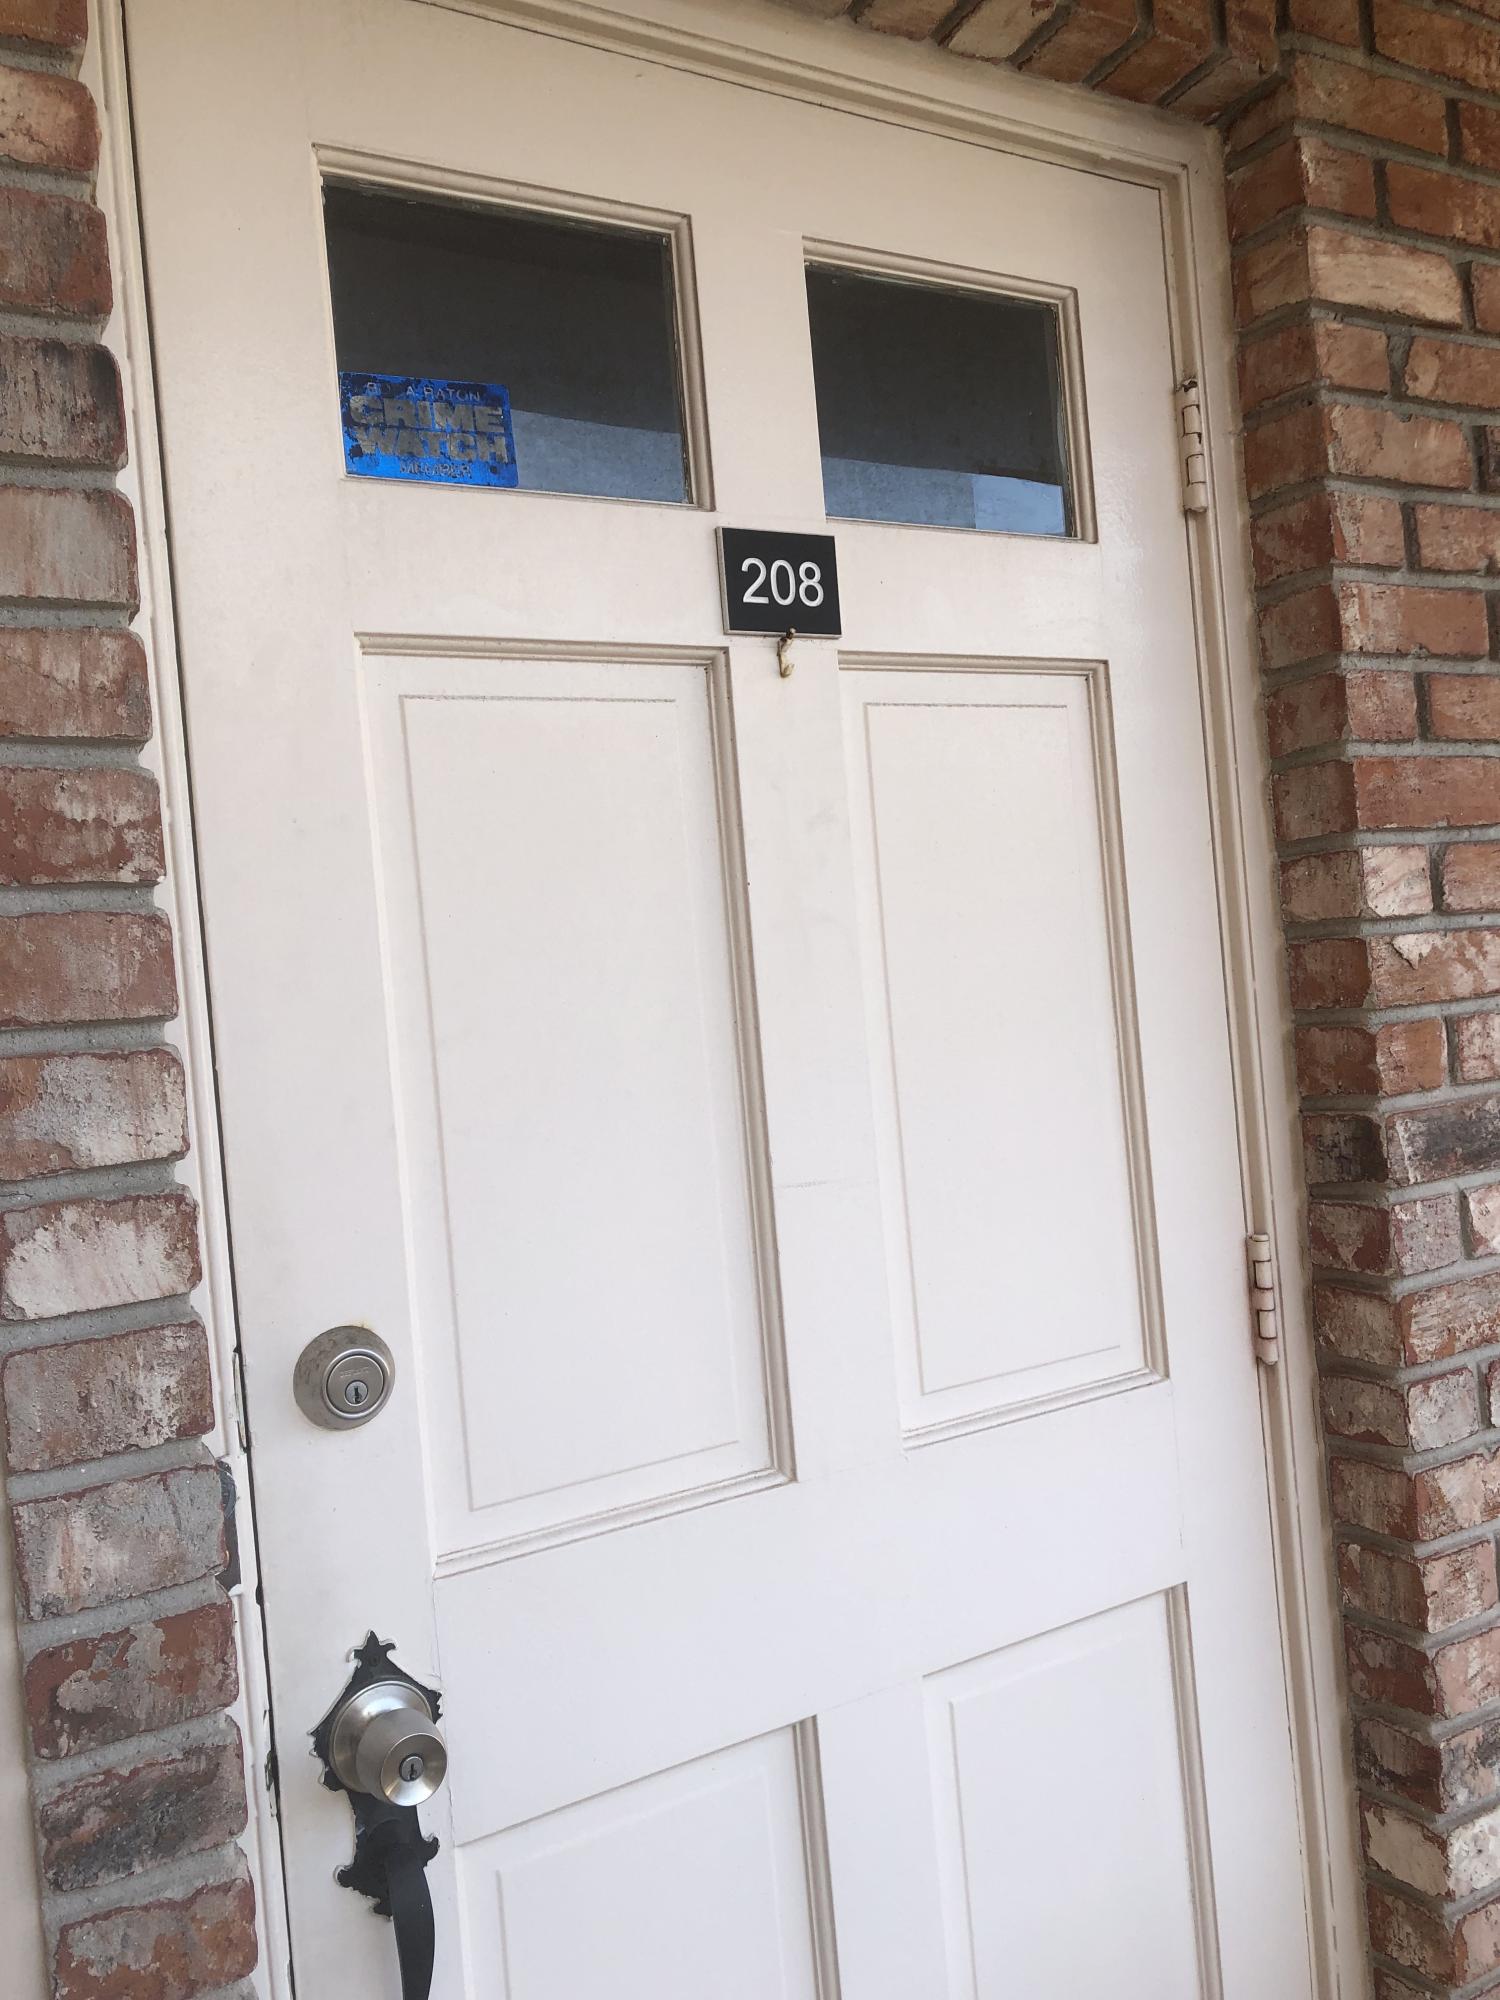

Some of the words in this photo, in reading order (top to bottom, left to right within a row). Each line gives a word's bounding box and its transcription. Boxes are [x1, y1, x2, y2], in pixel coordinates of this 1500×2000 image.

[424, 386, 480, 402] RATON
[350, 395, 504, 433] CRIME
[352, 426, 508, 463] WATCH
[741, 557, 824, 607] 208
